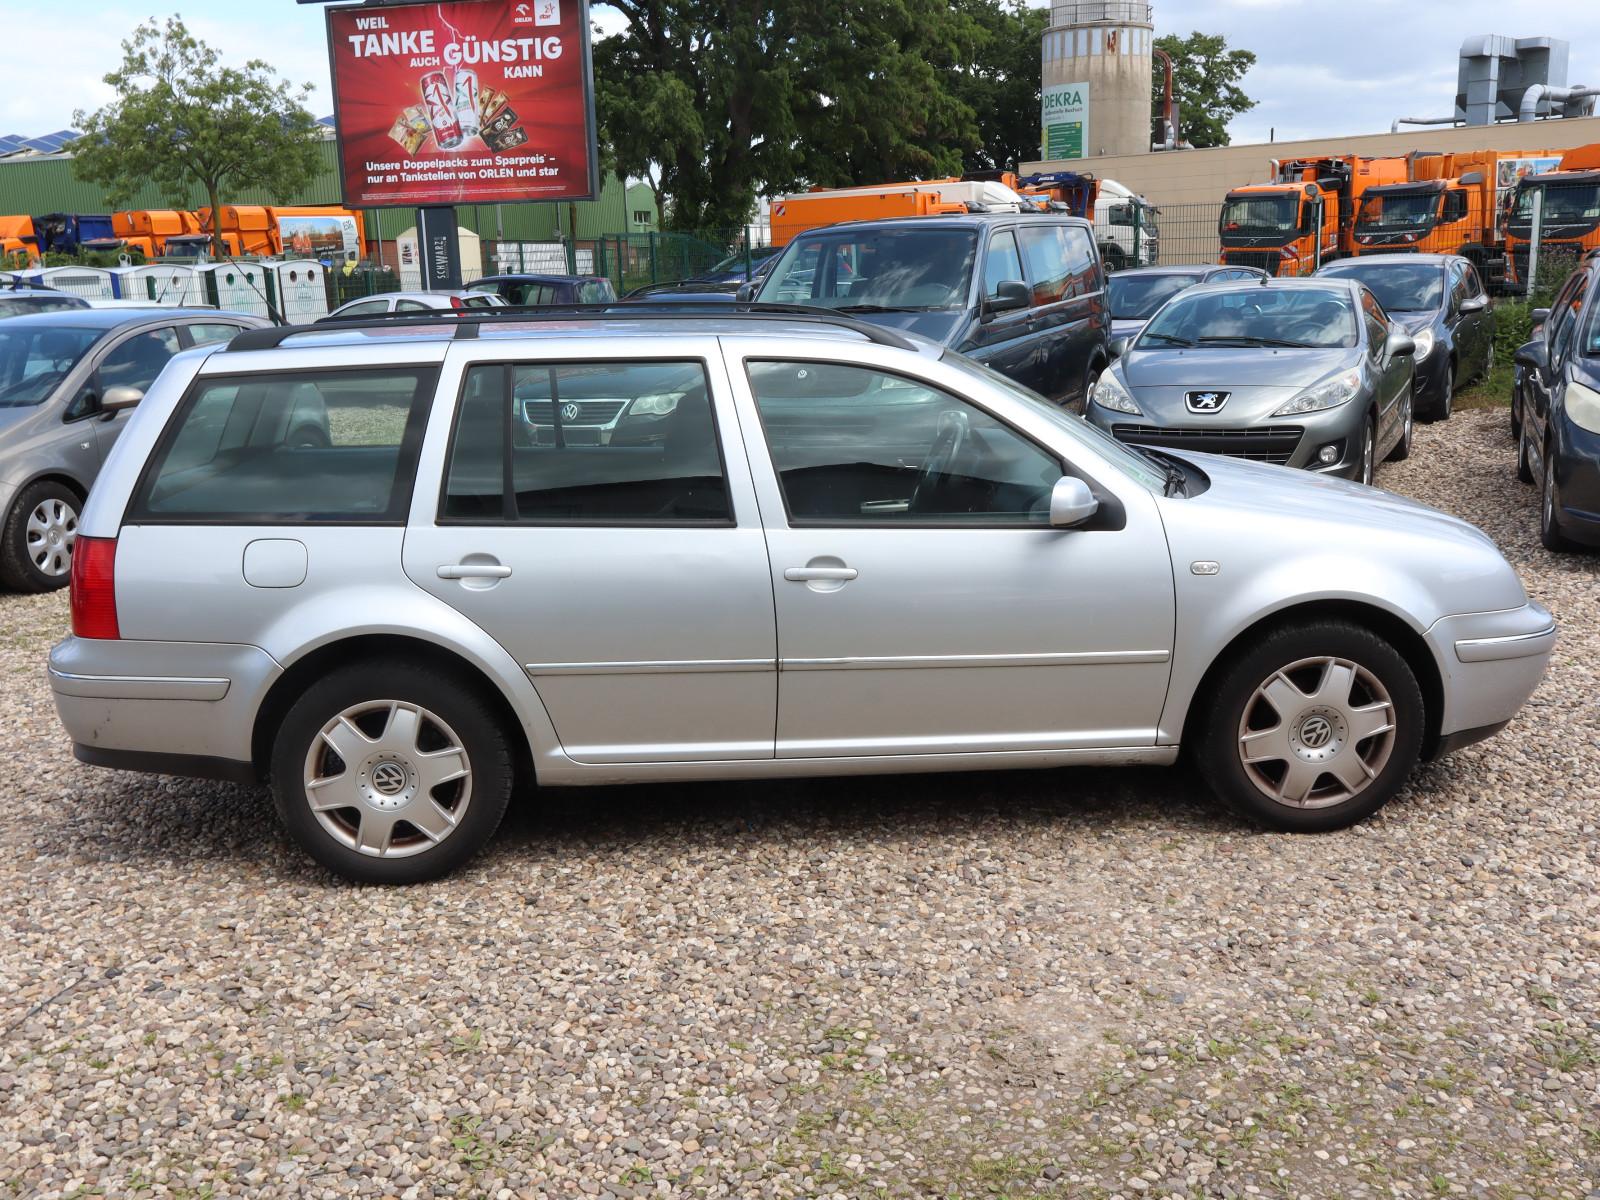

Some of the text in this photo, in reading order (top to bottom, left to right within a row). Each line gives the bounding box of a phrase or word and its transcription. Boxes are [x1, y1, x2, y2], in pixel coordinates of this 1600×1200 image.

[355, 16, 389, 30] WEIL
[348, 30, 435, 57] TANKE
[443, 35, 562, 65] GÜNSTIG
[410, 56, 440, 68] AUCH
[504, 65, 543, 79] KANN
[1044, 90, 1082, 109] DEKRA
[366, 161, 400, 171] Unsere
[403, 158, 468, 170] Doppelpacks
[471, 158, 492, 167] zum
[367, 166, 559, 183] nur an Tankstellen von ORLEN und star
[434, 241, 448, 279] SCHWARZ
